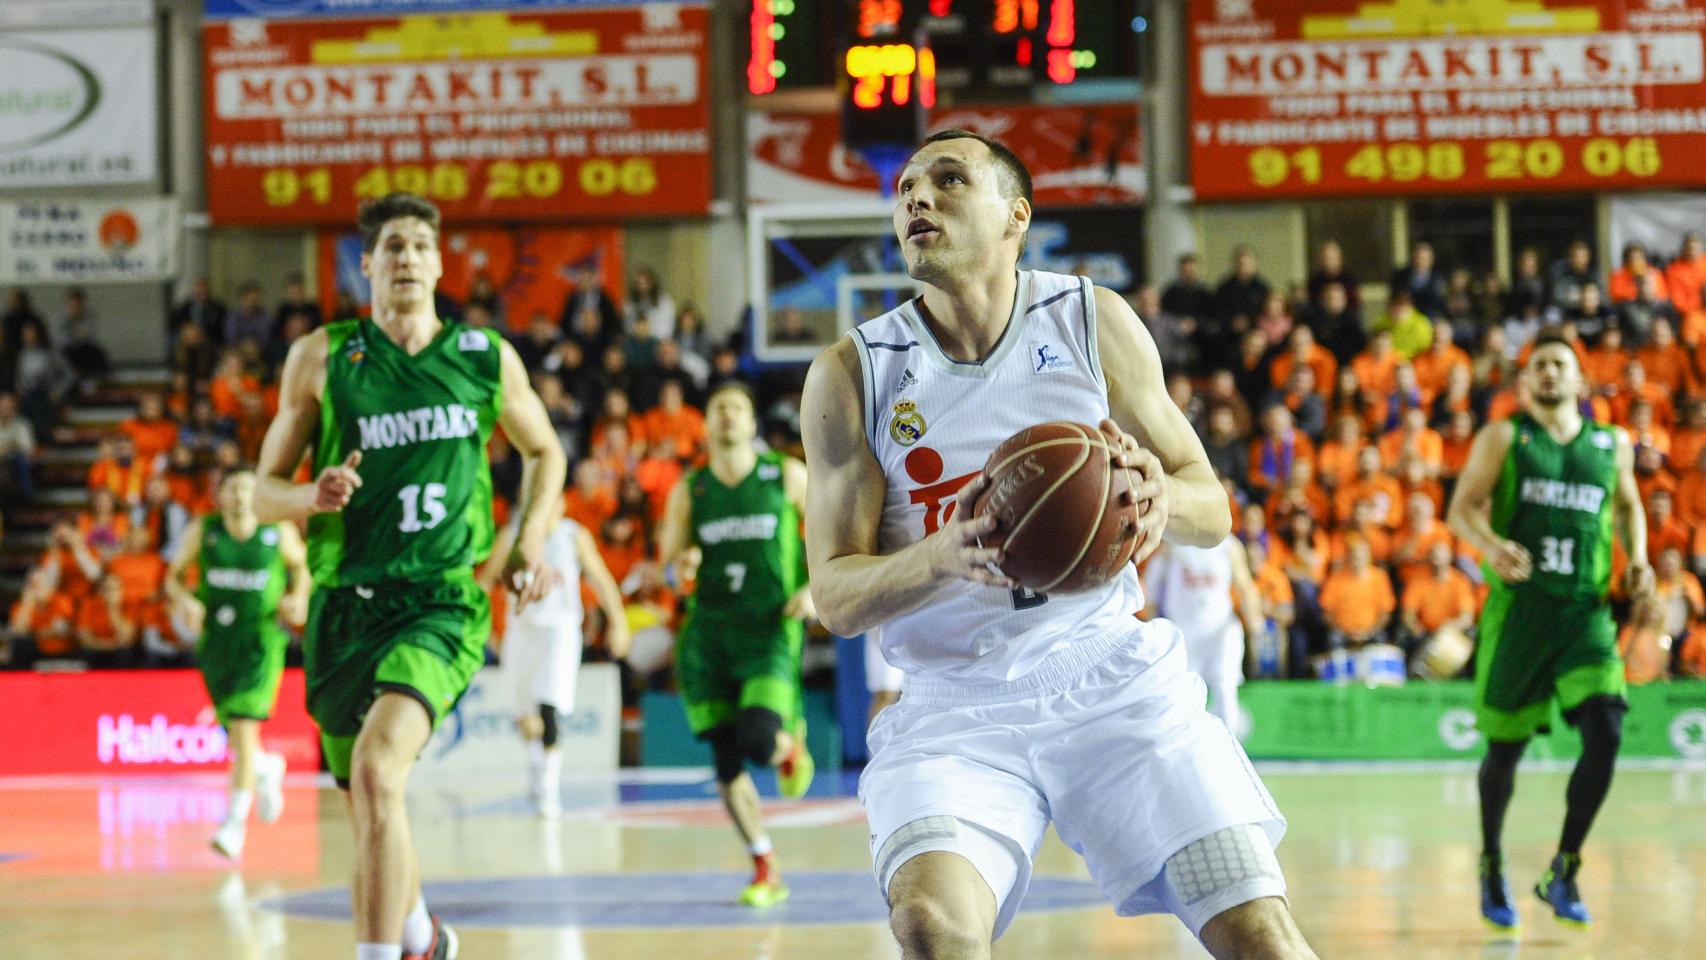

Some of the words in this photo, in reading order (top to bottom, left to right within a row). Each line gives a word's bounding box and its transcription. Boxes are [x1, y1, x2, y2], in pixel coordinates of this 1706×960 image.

[240, 67, 562, 108] MONTAKIT,
[582, 62, 680, 98] S.L.
[1225, 46, 1563, 87] MONTAKIT,
[1584, 43, 1682, 76] S.L.
[1384, 116, 1418, 141] DE
[1555, 110, 1591, 137] DE
[261, 166, 332, 208] 91
[354, 162, 468, 200] 498
[487, 157, 563, 199] 20
[577, 155, 658, 197] 06
[1250, 145, 1321, 187] 91
[1345, 141, 1465, 182] 498
[1485, 139, 1565, 179] 20
[1581, 136, 1662, 177] 06
[398, 482, 448, 533] 15
[725, 562, 747, 593] 7
[1540, 535, 1576, 575] 31
